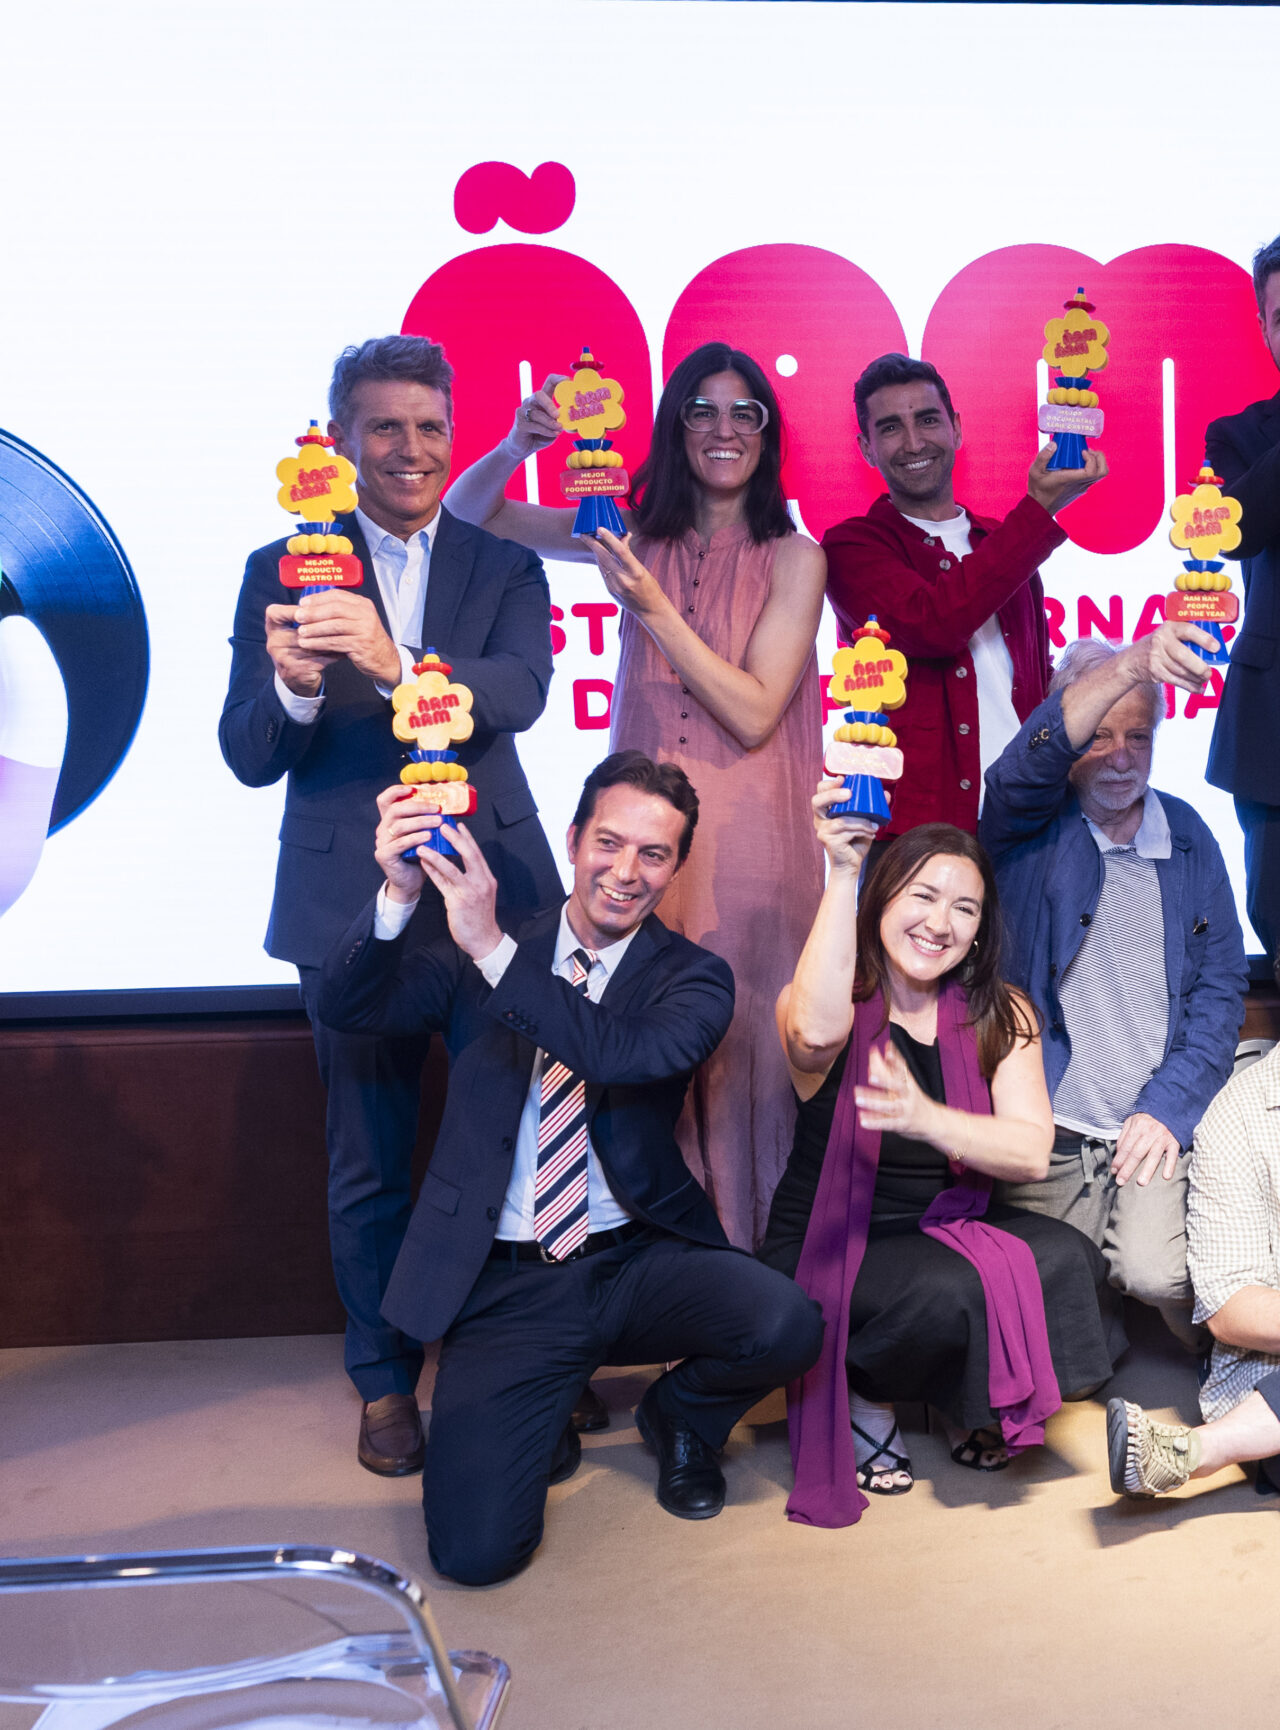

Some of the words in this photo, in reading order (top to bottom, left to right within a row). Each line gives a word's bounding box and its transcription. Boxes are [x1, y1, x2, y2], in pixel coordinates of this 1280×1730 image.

[574, 478, 613, 486] PRODUCTO
[1184, 594, 1201, 602] ÑAM
[1202, 594, 1219, 602] ÑAM
